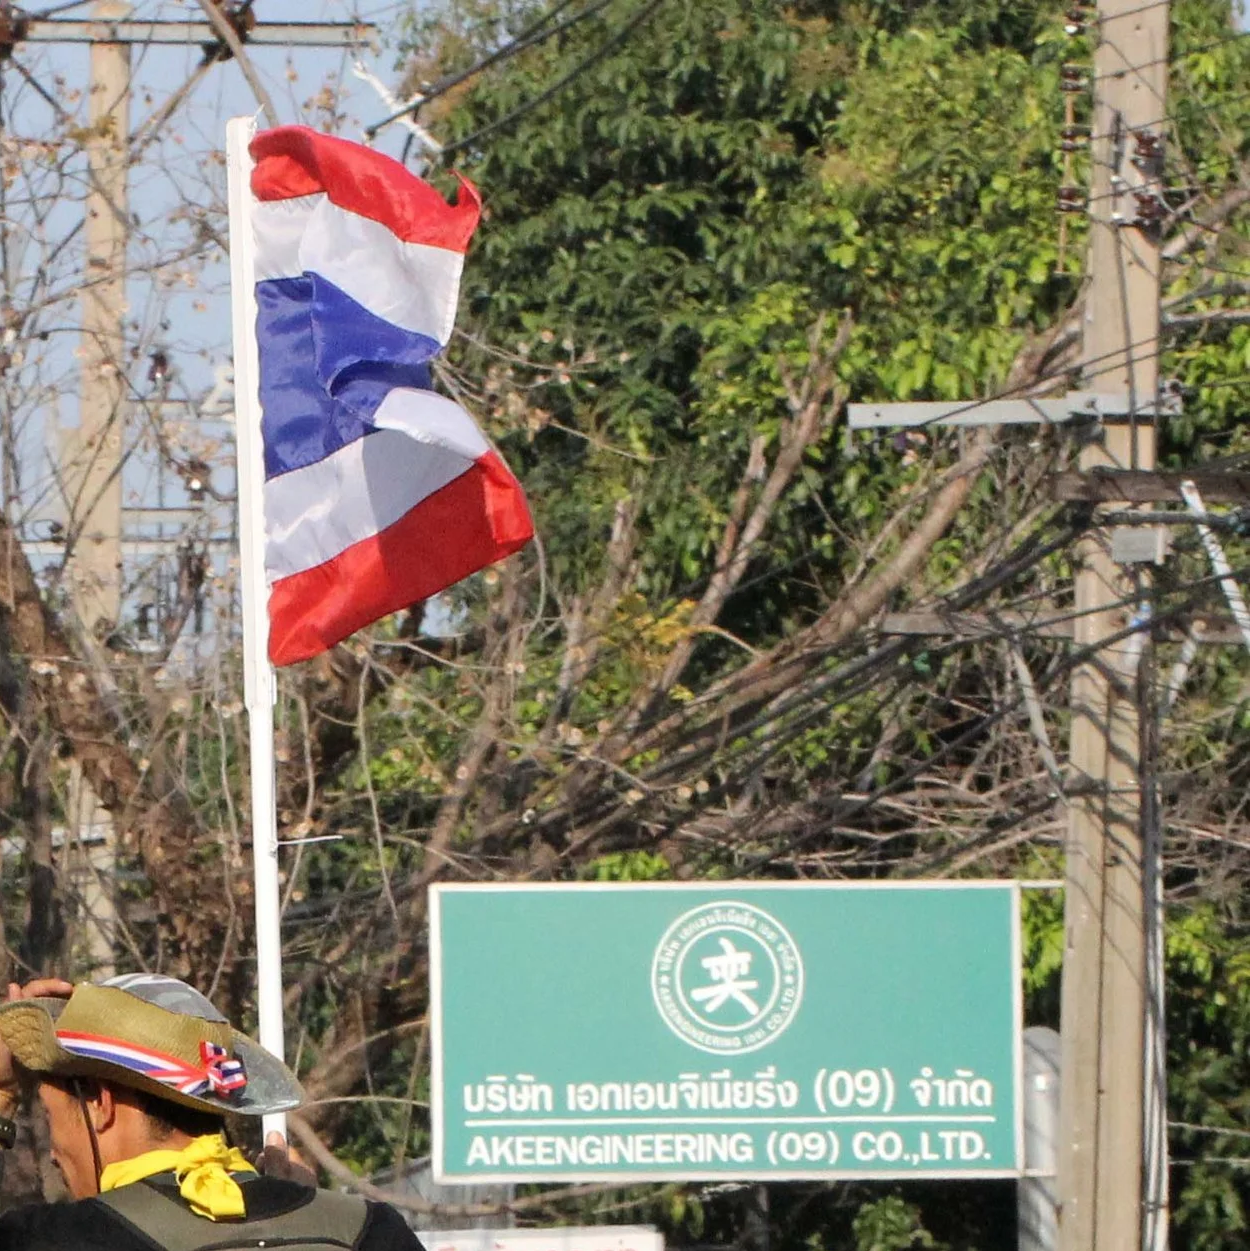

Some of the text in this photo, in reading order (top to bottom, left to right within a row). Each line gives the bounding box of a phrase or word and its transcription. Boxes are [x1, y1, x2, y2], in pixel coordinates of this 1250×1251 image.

[464, 1066, 993, 1113] บริษัท เอกเอนจิเนียริ่ง (09) จำกัด
[466, 1130, 992, 1166] AKEENGINEERING (09) CO.,LTD.
